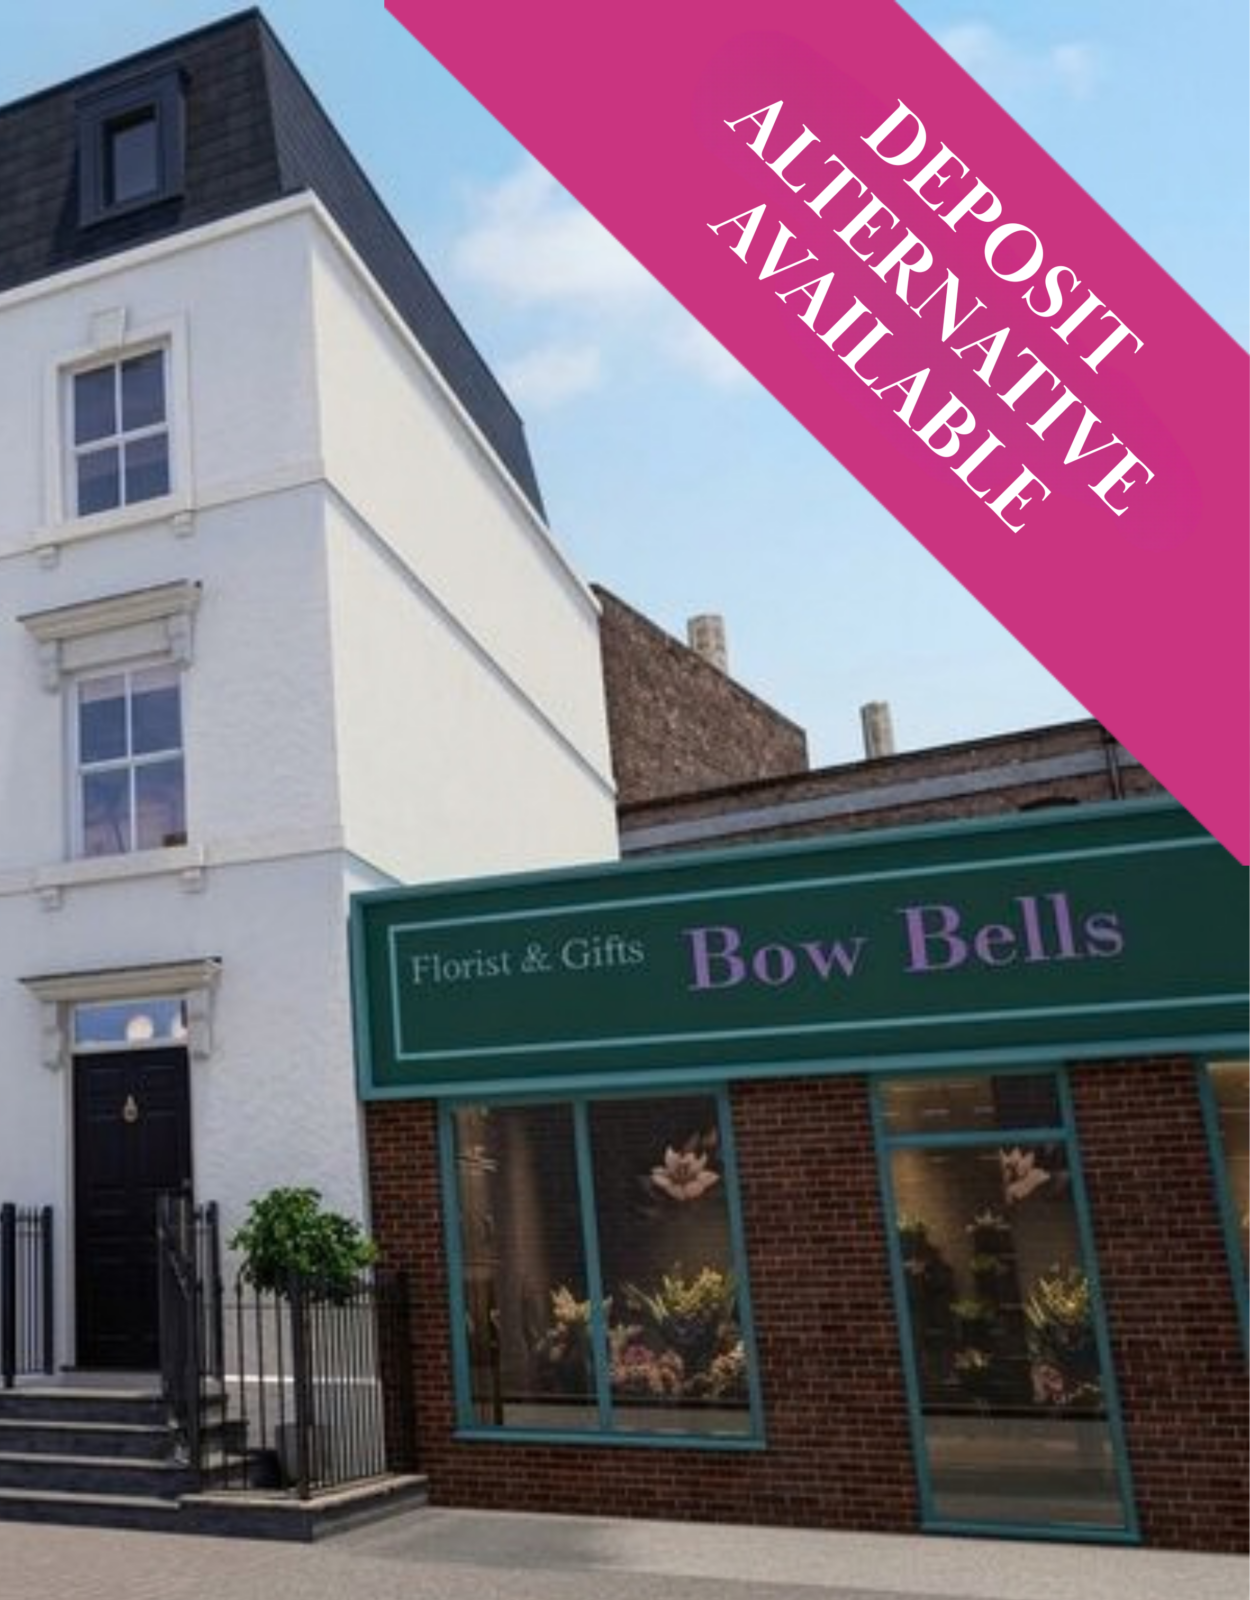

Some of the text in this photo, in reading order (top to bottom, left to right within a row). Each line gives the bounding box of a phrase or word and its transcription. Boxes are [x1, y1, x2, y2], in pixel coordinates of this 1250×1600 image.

[410, 935, 646, 986] Florist & Gifts
[682, 891, 1126, 991] Bow Bells
